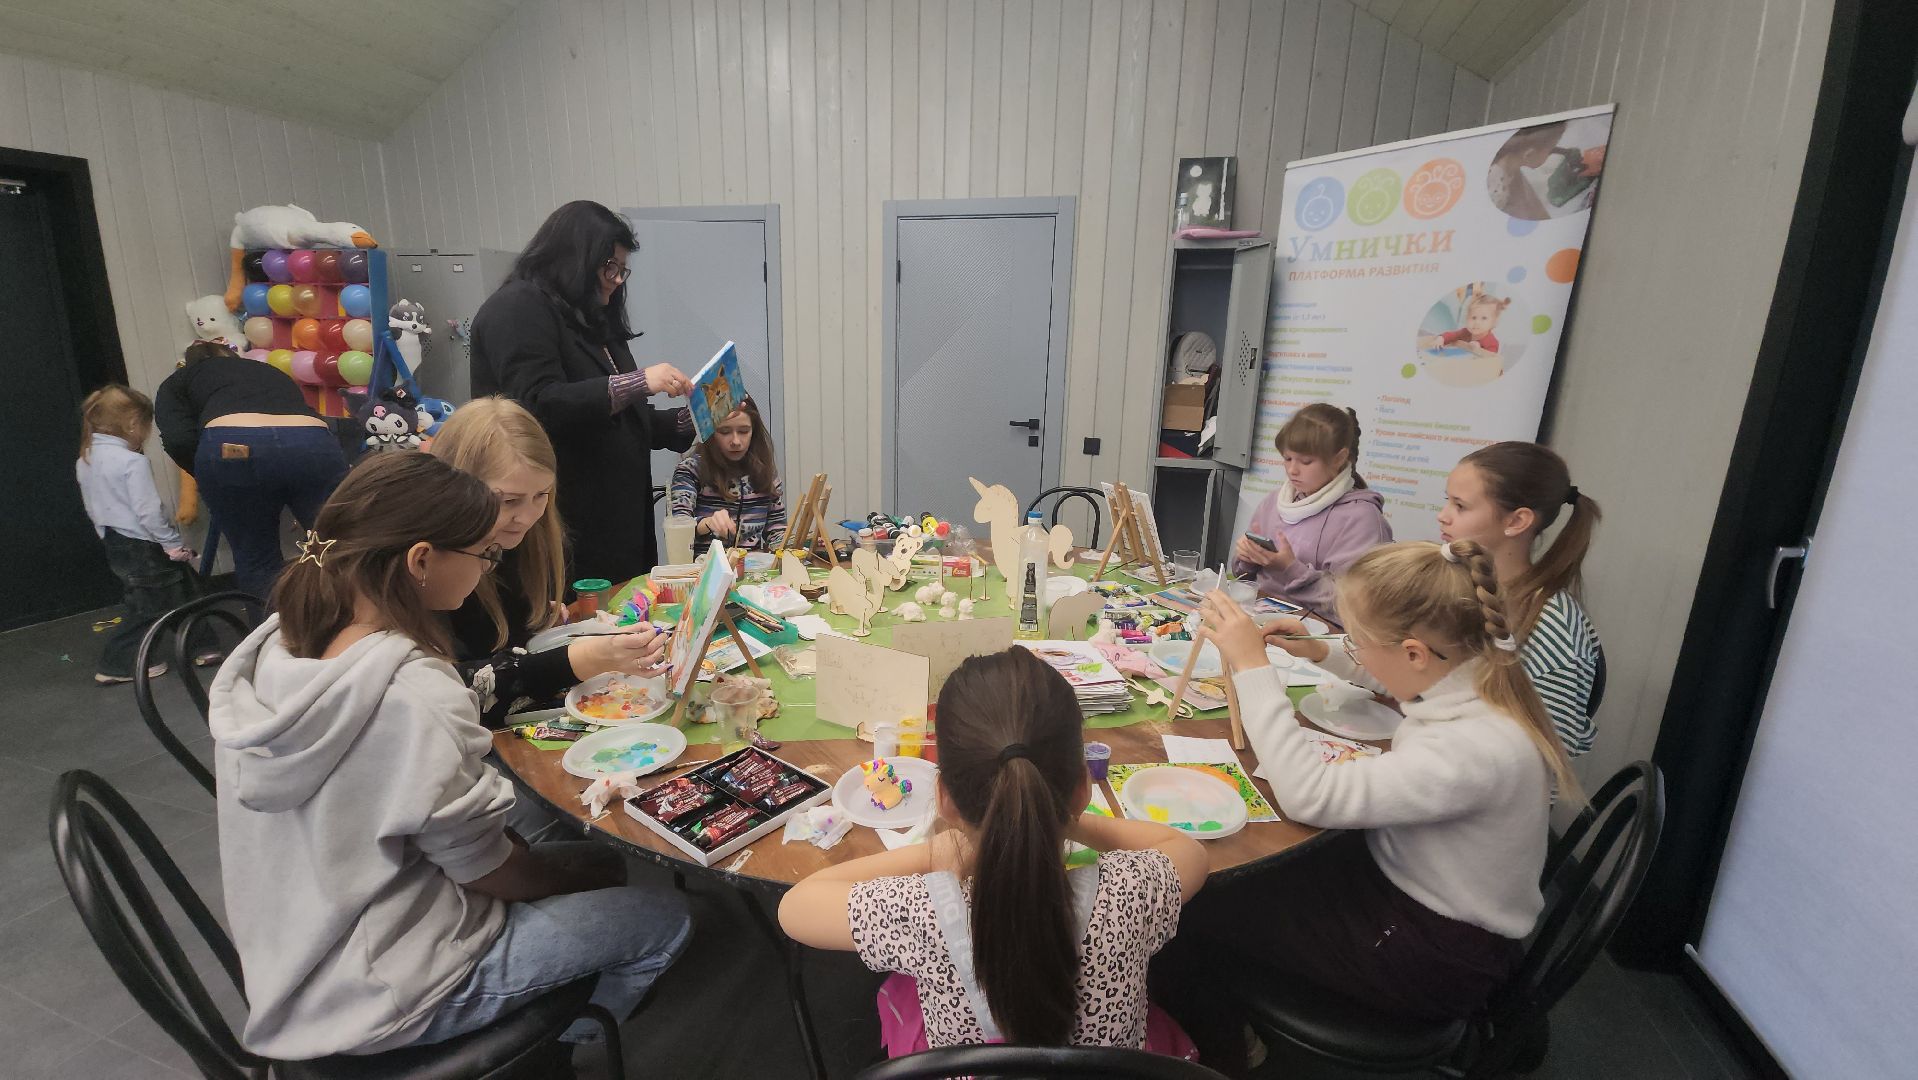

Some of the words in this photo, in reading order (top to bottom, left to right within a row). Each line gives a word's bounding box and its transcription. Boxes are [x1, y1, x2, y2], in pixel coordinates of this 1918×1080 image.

[1287, 229, 1457, 263] Умнички
[1288, 268, 1366, 282] ПЛАТФОРМА
[1369, 263, 1441, 278] РАЗВИТИЯ
